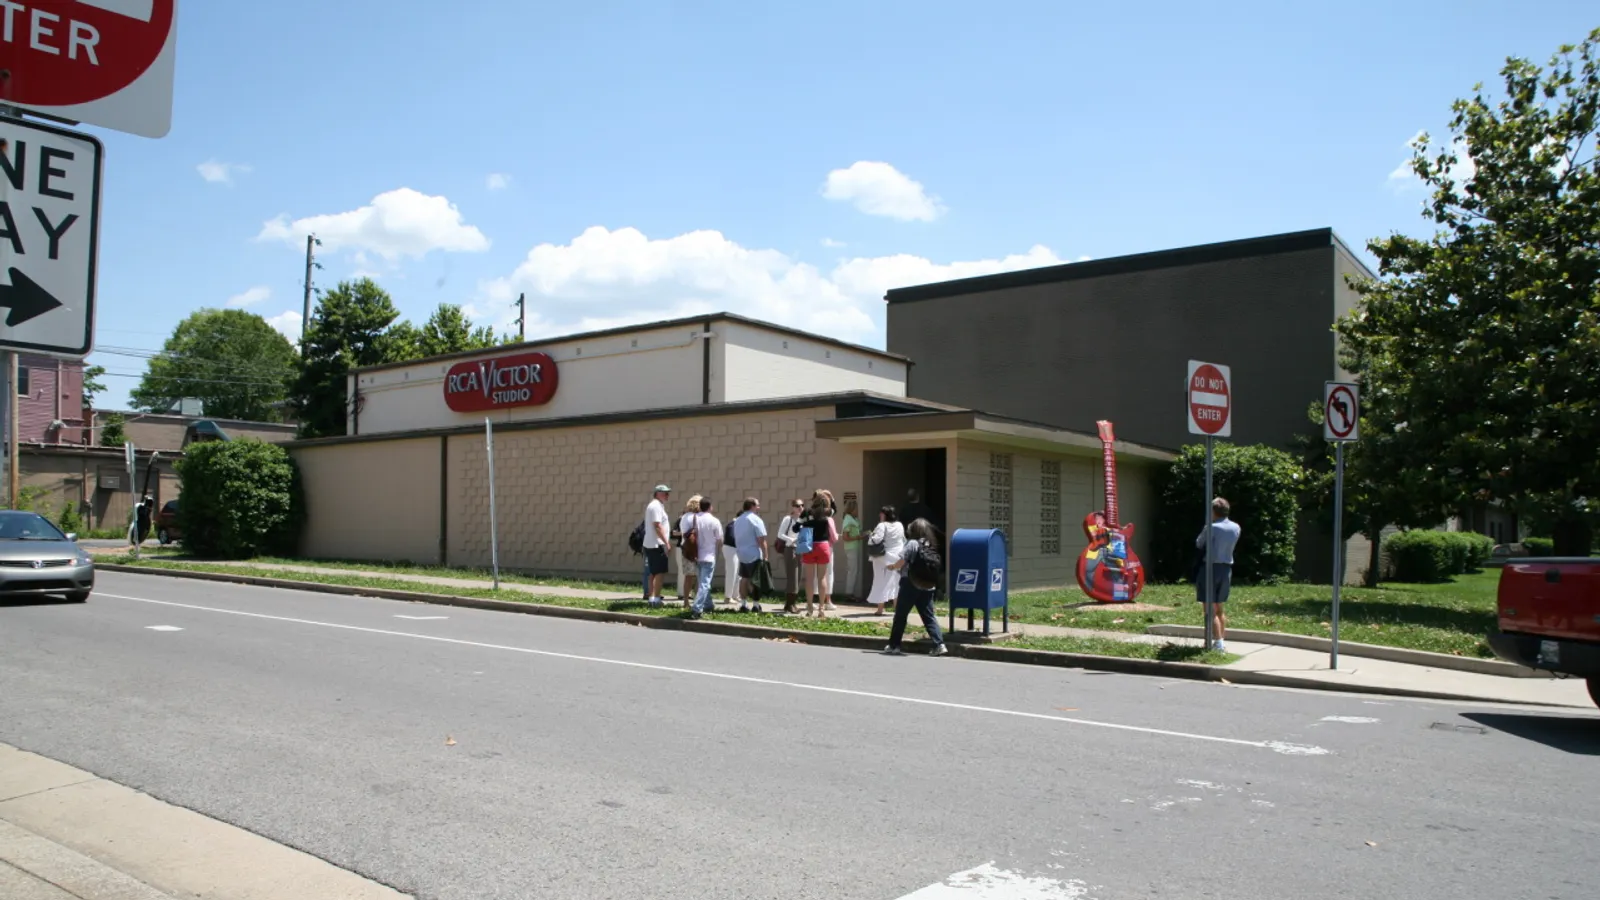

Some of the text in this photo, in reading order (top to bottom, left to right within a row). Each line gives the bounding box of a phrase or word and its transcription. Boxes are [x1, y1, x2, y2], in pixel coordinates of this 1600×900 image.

[0, 0, 100, 66] TER
[448, 360, 541, 398] RCA VICTOR
[1195, 376, 1224, 390] DO NOT
[492, 389, 530, 404] STUDIO
[1198, 408, 1221, 421] ENTER
